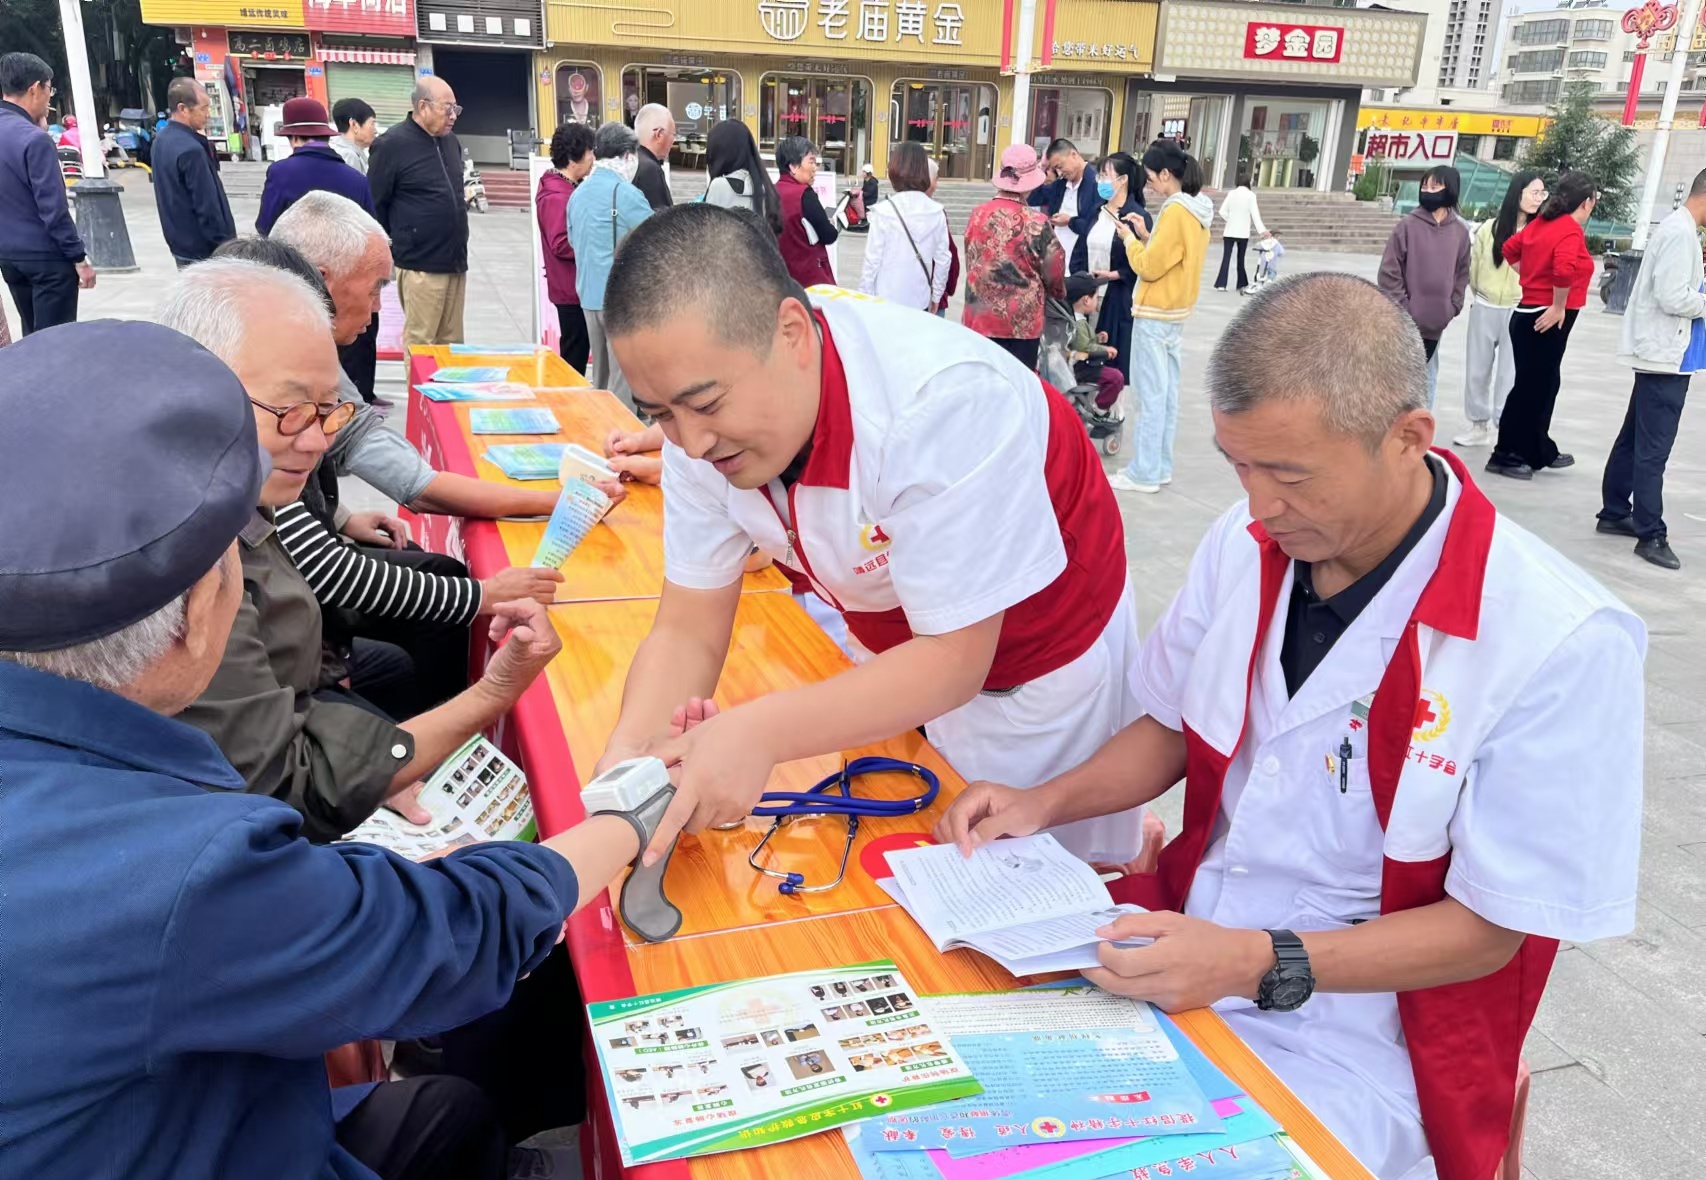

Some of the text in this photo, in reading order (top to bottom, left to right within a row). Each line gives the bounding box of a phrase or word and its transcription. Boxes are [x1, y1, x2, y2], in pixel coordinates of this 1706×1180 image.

[816, 0, 965, 46] 老庙黄金
[1254, 26, 1339, 59] 梦金园
[1365, 133, 1454, 160] 超市入口
[853, 550, 890, 575] 靖远县
[739, 1102, 864, 1139] 红十字应急救护知识
[880, 1113, 1197, 1143] 提倡红十字精神 人道 博爱 奉献
[1133, 1145, 1240, 1180] 人人学急救
